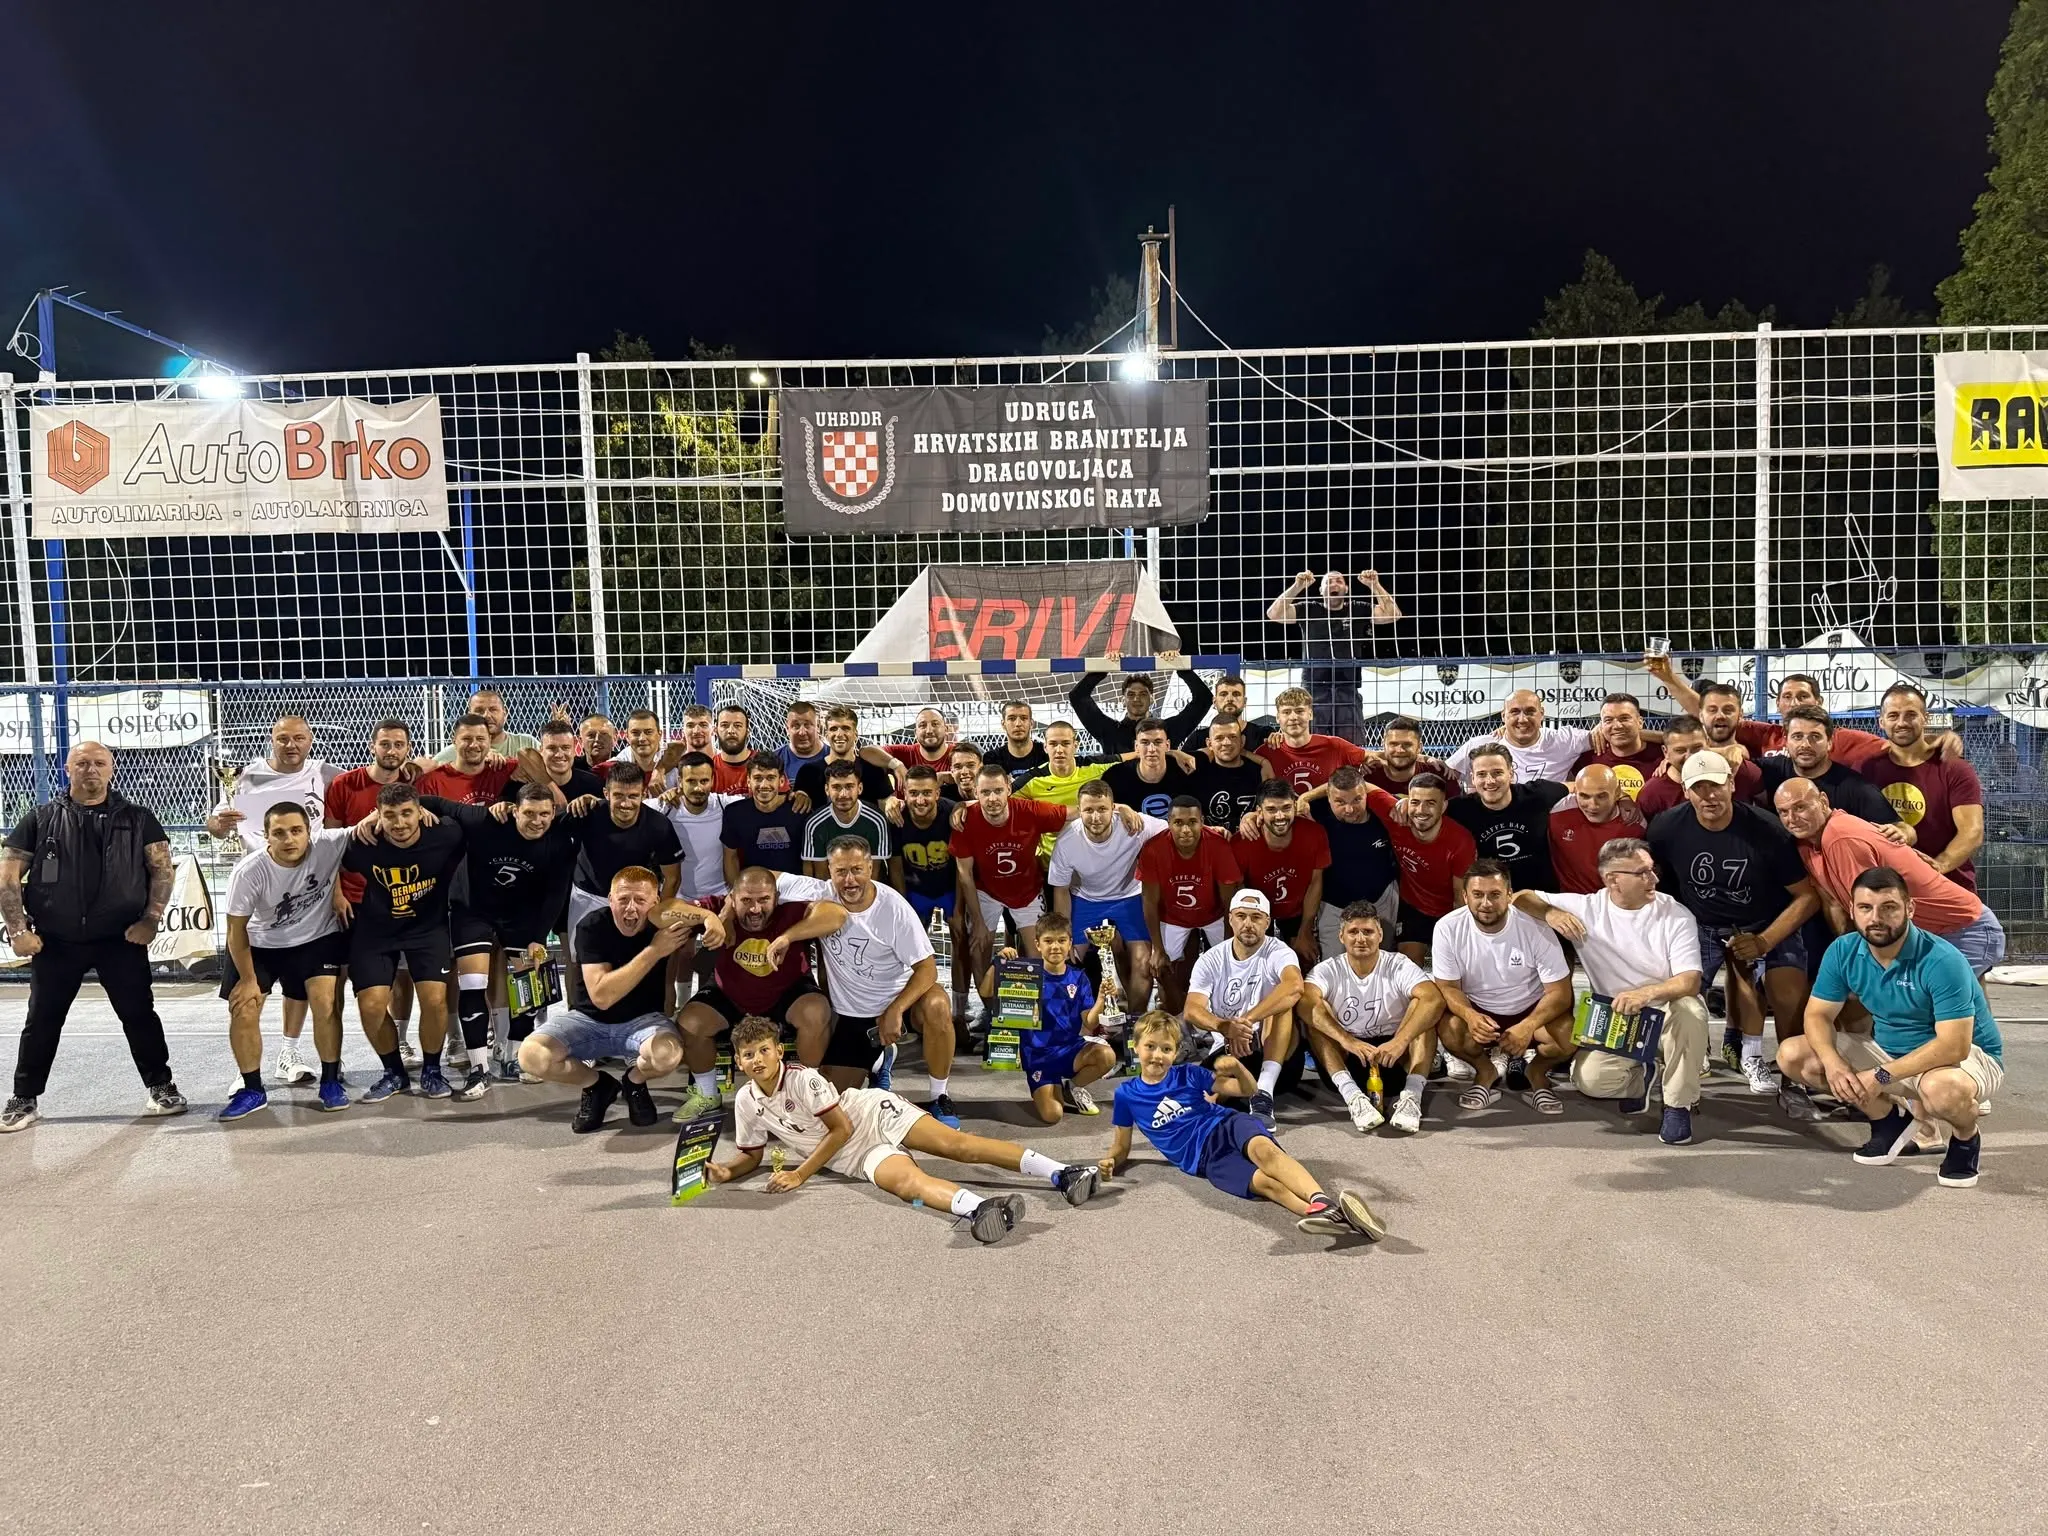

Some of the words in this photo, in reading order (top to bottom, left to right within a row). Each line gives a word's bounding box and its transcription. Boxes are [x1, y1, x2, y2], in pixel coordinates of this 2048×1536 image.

[815, 410, 883, 428] UHBDDR
[1004, 399, 1096, 423] UDRUGA
[123, 419, 432, 486] AutoBrko
[913, 430, 1039, 454] HRVATSKIH
[1050, 427, 1188, 451] BRANITELJA
[968, 458, 1134, 484] DRAGOVOLJACA
[52, 503, 223, 525] AUTOLIMARIJA
[251, 499, 429, 521] AUTOLAKIRNICA
[942, 488, 1095, 513] DOMOVINSKOG
[1105, 488, 1162, 509] RATA
[1412, 686, 1485, 706] OSJEČKO
[1535, 686, 1607, 706] OSJEČKO
[107, 711, 198, 737] OSJEČKO
[1307, 762, 1320, 771] BAR
[1293, 772, 1313, 797] 5
[1481, 823, 1505, 840] CAFFE
[1508, 822, 1526, 833] BAR
[1495, 833, 1521, 858] 5
[494, 865, 521, 886] 5
[997, 851, 1017, 875] 5
[1690, 851, 1748, 889] 67
[391, 877, 437, 898] GERMANIA
[1175, 885, 1197, 908] 5
[393, 894, 411, 907] KUP
[1222, 974, 1262, 1007] 67
[1336, 996, 1382, 1030] 67
[1595, 1009, 1608, 1036] SENIORI
